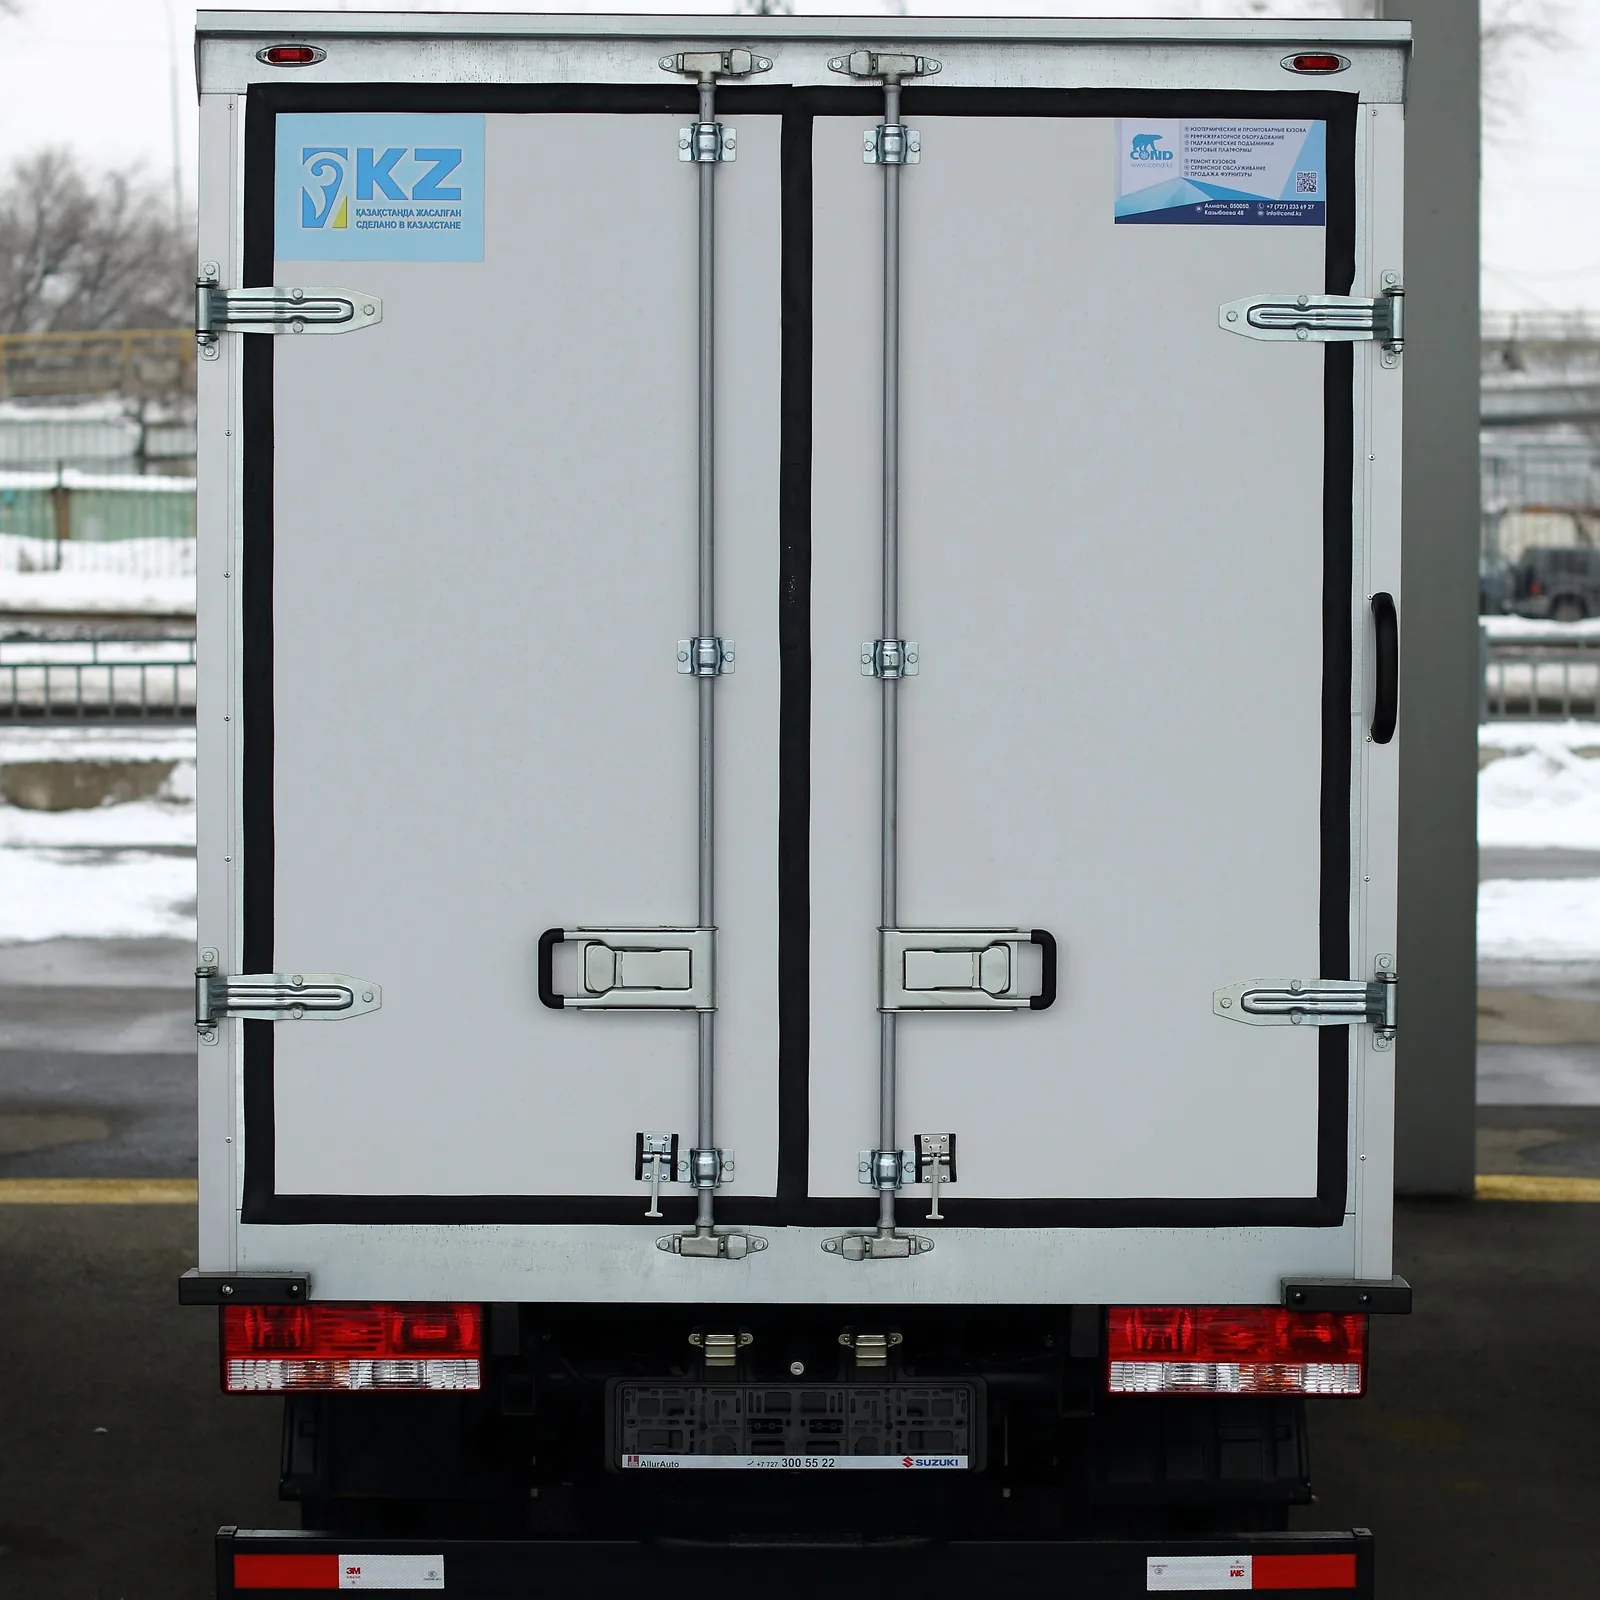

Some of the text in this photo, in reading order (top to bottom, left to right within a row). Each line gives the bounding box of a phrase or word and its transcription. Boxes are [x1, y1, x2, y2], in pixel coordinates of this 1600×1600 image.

[1130, 150, 1173, 160] COND
[356, 148, 461, 200] KZ
[355, 208, 462, 218] ҚАЗАҚСТАНДА ЖАСАЛҒАН
[356, 221, 461, 230] СДЕЛАНО В КАЗАХСТАНЕ
[640, 1459, 680, 1468] AllurAuto
[781, 1458, 801, 1468] 300
[804, 1458, 819, 1468] 55
[821, 1458, 835, 1468] 22
[346, 1567, 361, 1575] 3M
[1230, 1569, 1245, 1577] 3M
